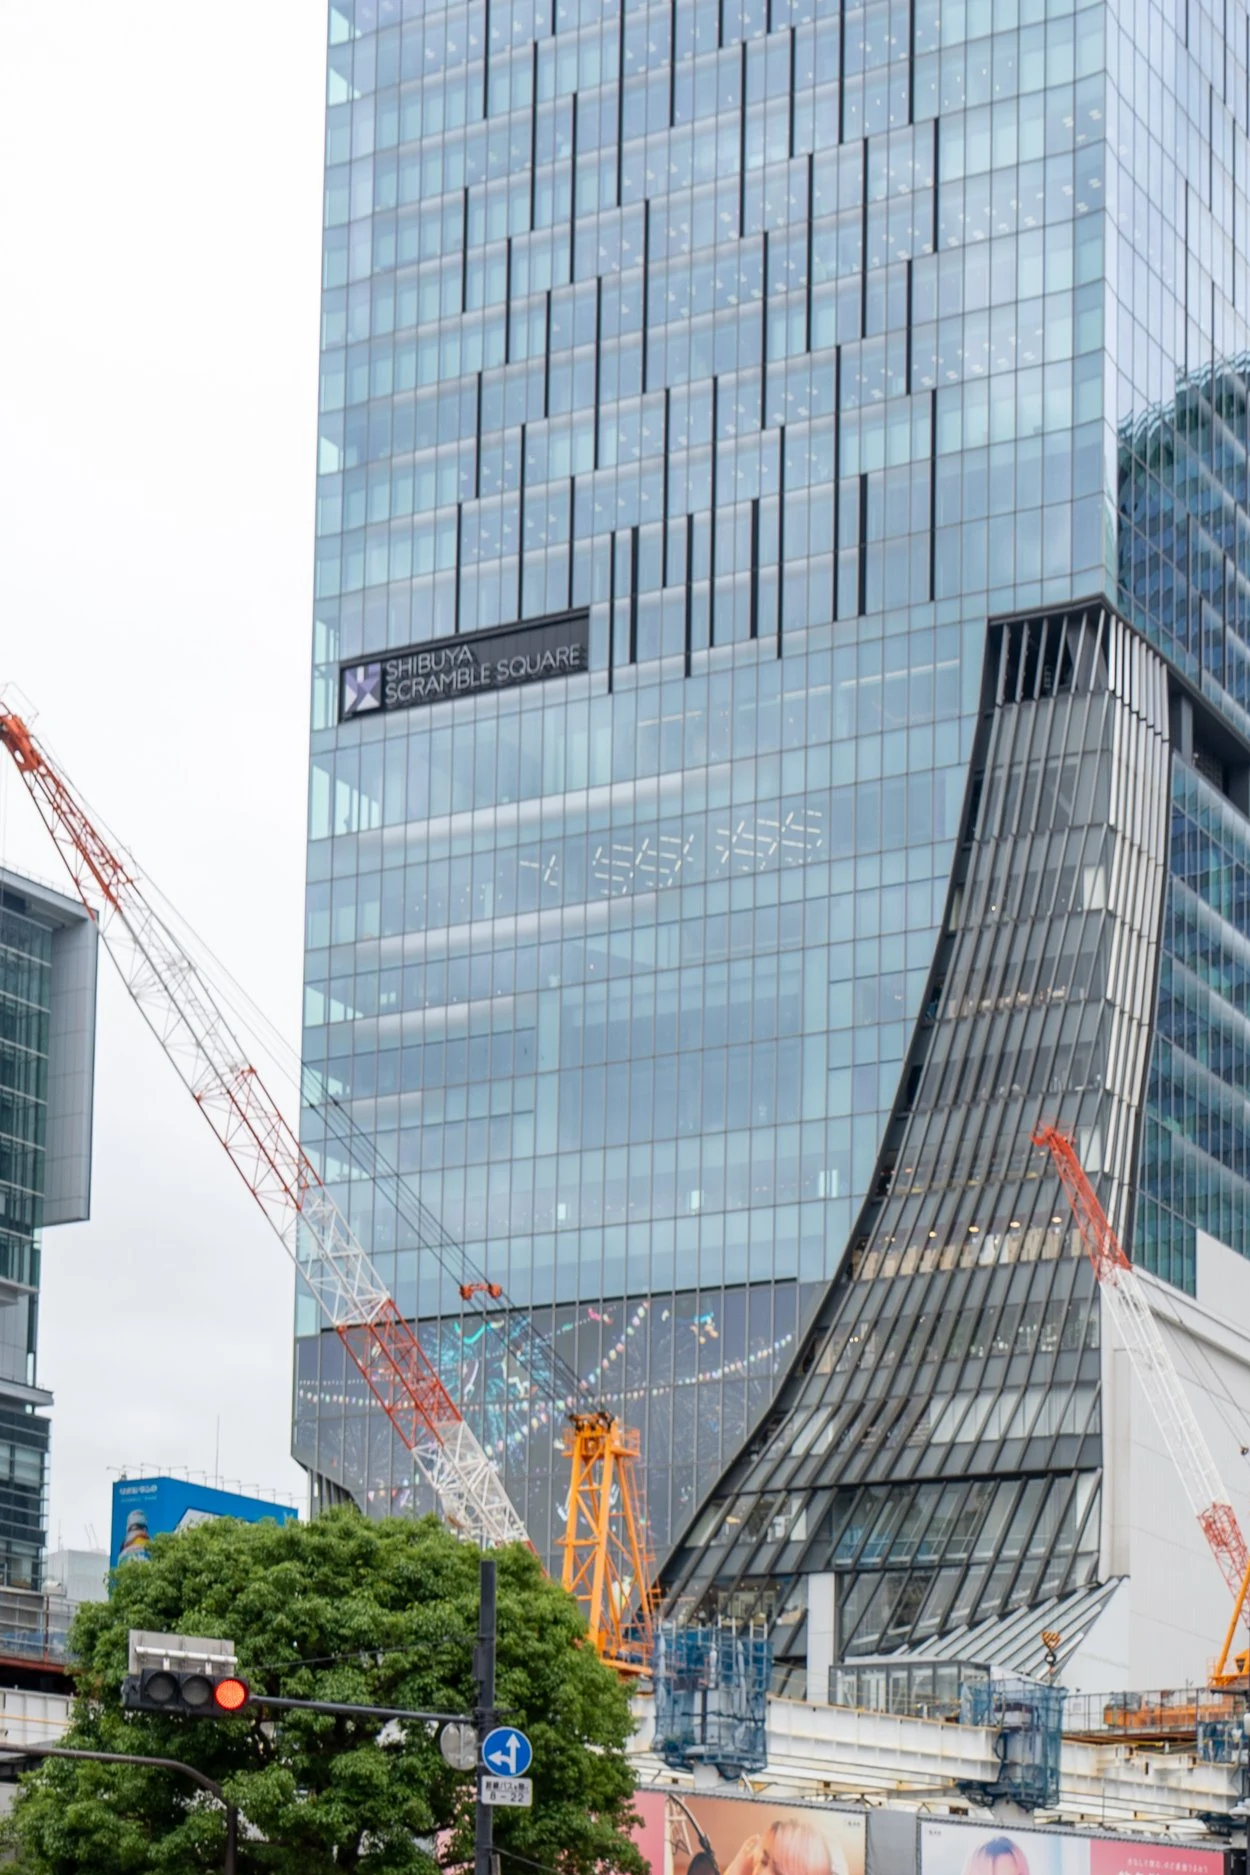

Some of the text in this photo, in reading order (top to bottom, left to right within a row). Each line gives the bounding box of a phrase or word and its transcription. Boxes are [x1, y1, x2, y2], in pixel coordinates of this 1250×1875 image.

[385, 644, 474, 682] SHIBUYA
[385, 643, 581, 702] SCRAMBLE SQUARE
